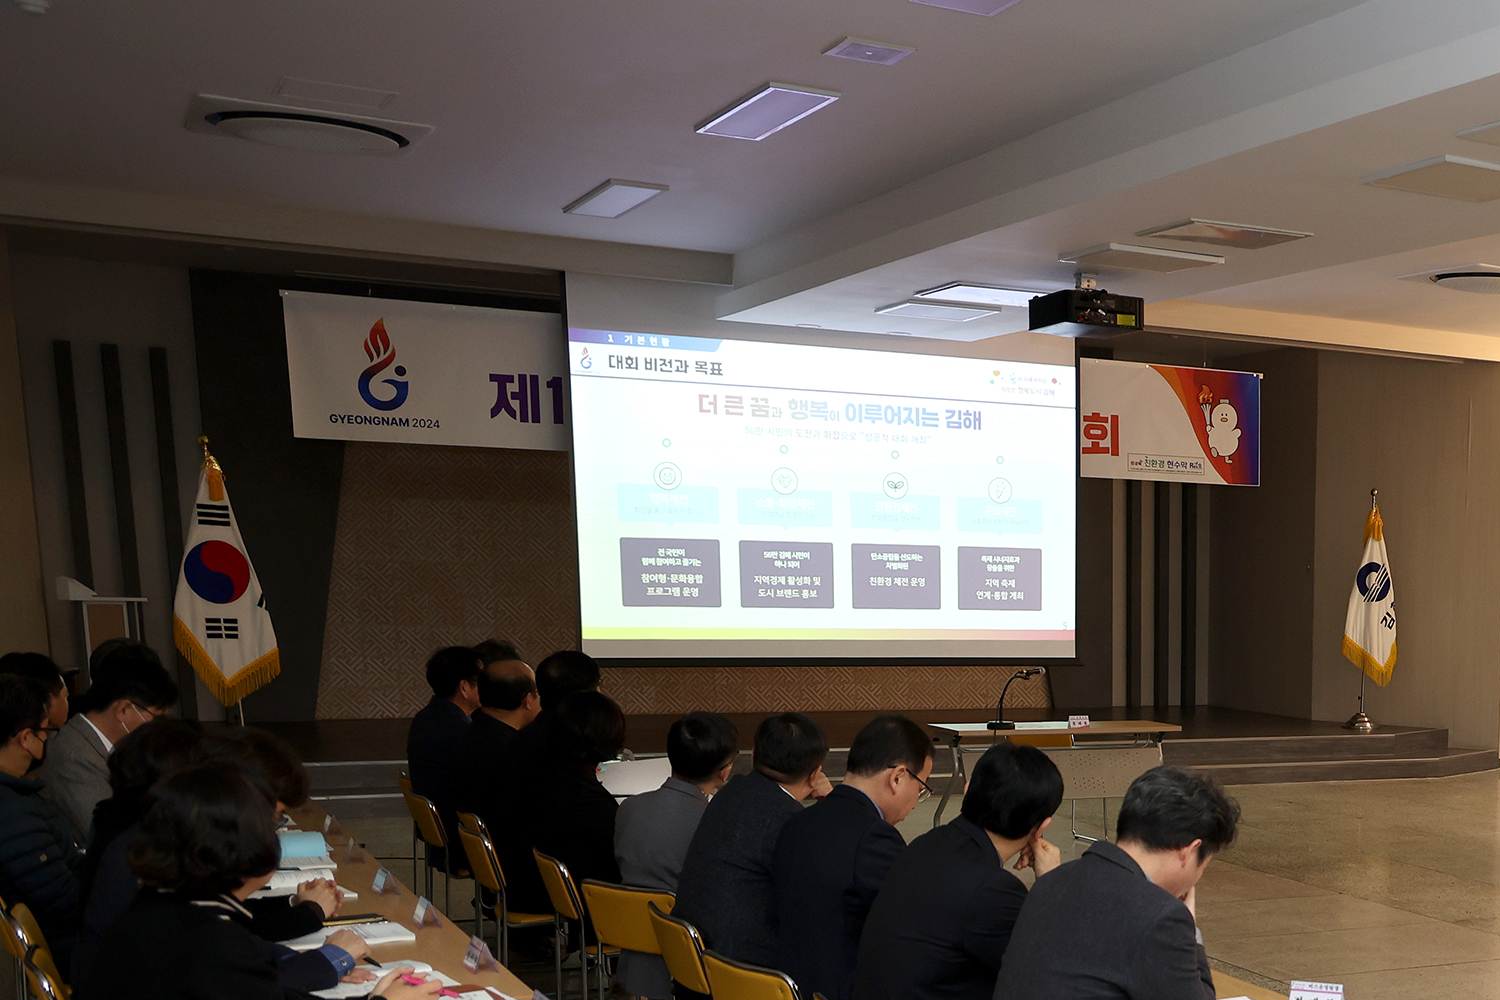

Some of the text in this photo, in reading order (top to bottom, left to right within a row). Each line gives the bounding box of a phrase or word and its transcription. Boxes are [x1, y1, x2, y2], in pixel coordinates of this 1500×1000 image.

[607, 333, 671, 348] 1 기본현황
[608, 354, 723, 376] 대회 비전과 목표
[489, 373, 564, 425] 제1
[699, 393, 982, 430] 더 큰 꿈과 행복이 이루어지는 김해
[329, 413, 440, 429] GYEONGNAM 2024
[744, 426, 763, 438] 56만
[767, 427, 792, 438] 시민의
[795, 428, 821, 440] 도전과
[824, 429, 857, 441] 화합으로
[892, 432, 908, 443] 대회
[1082, 412, 1119, 456] 회
[1145, 458, 1165, 469] 친환경
[1167, 460, 1187, 469] 현수막
[649, 493, 689, 505] 행복체전
[874, 501, 918, 514] 친환경체전
[984, 505, 1017, 517] 문화체전
[665, 548, 686, 557] 국민이
[763, 551, 779, 560] 56만
[791, 551, 811, 560] 시민이
[900, 553, 923, 562] 선도하는
[656, 557, 682, 567] 참여하고
[682, 558, 702, 567] 즐기는
[774, 560, 801, 569] 하나 되어
[753, 575, 821, 586] 지역경제 활성화 및
[869, 577, 926, 587] 친환경 체전 운영
[985, 579, 1016, 588] 지역 축제
[646, 586, 699, 598] 프로그램 운영
[757, 588, 818, 599] 도시 브랜드 홍보
[1009, 591, 1024, 600] 개최
